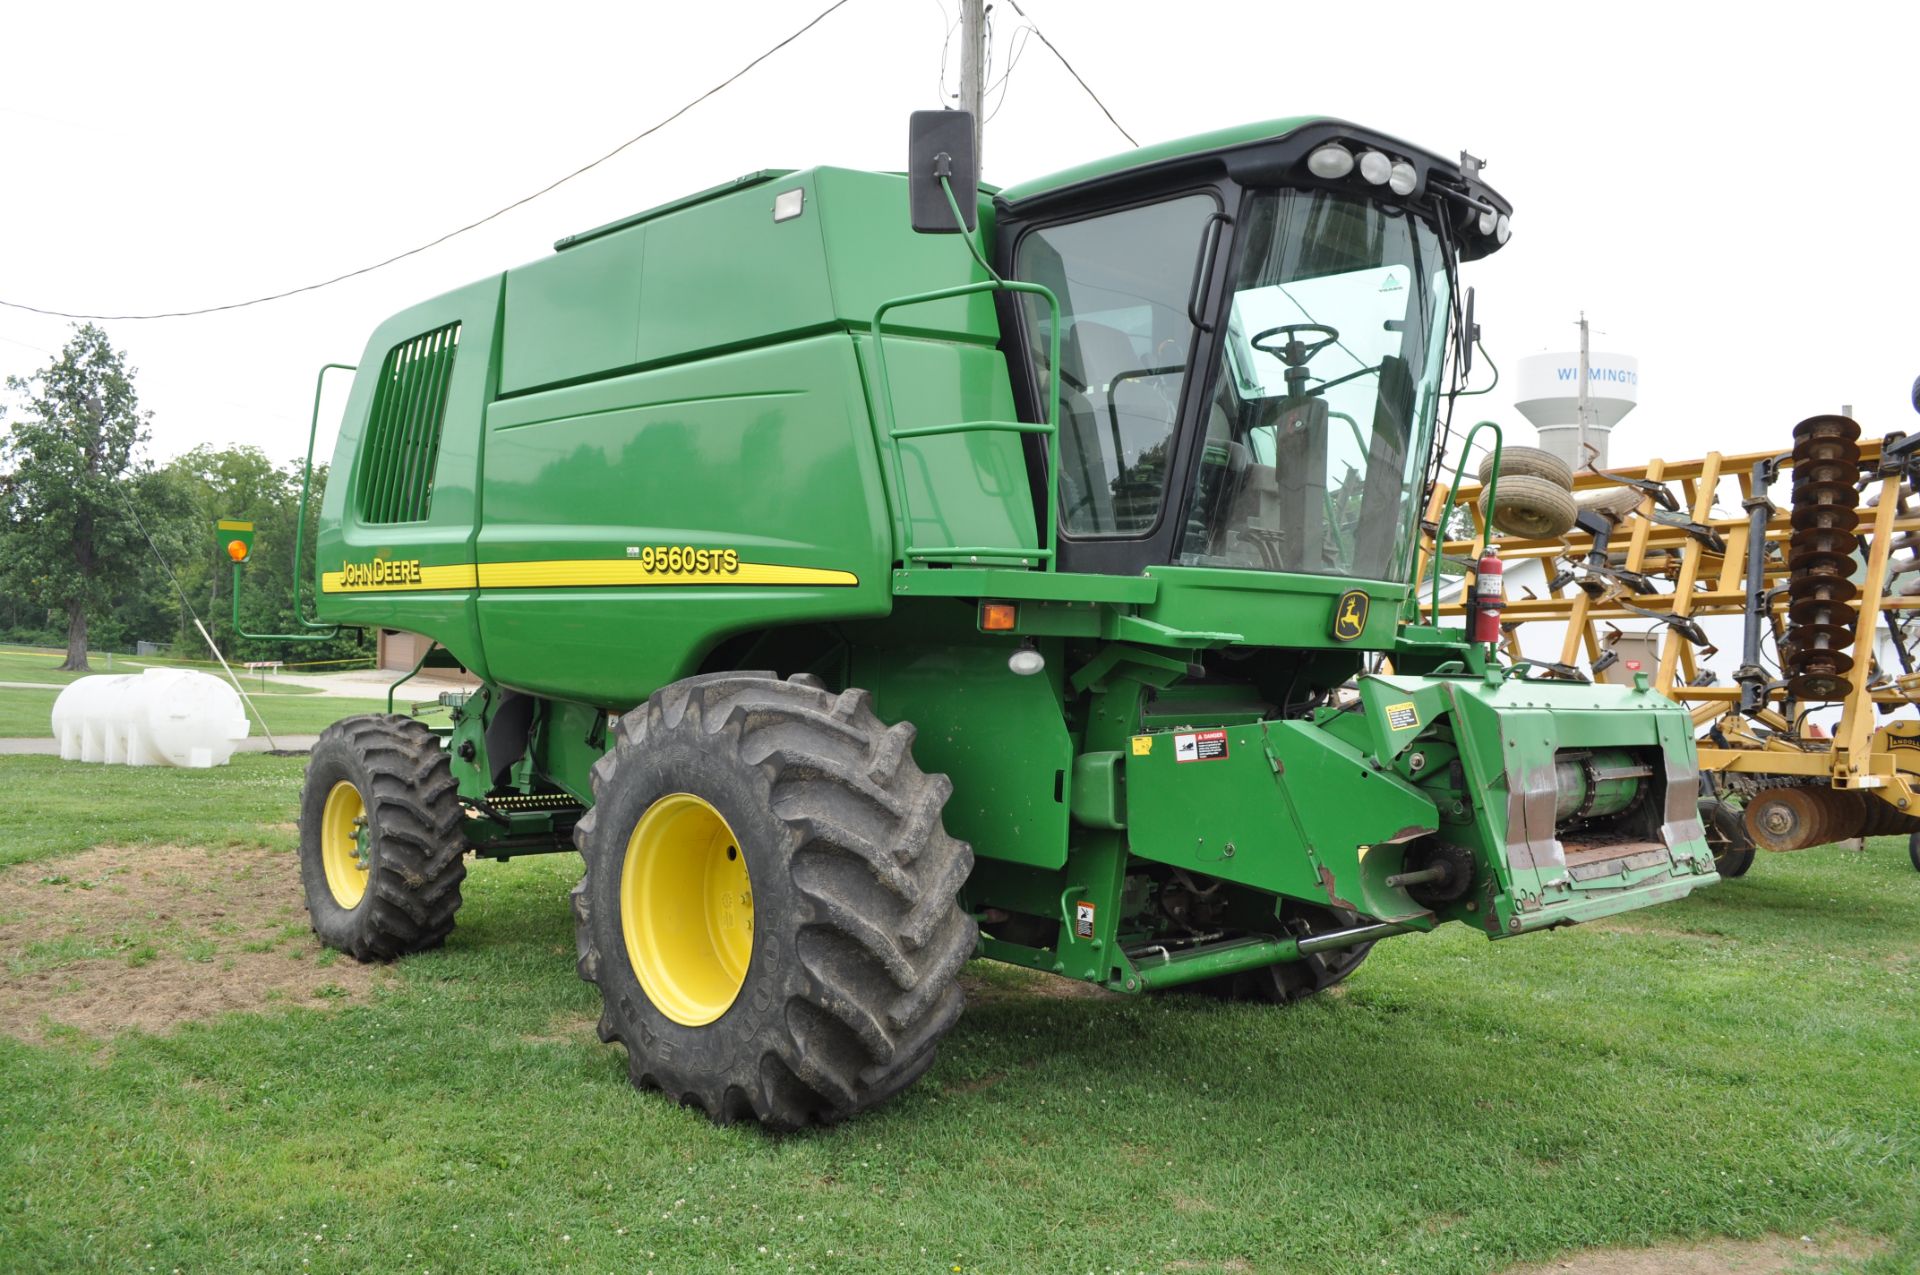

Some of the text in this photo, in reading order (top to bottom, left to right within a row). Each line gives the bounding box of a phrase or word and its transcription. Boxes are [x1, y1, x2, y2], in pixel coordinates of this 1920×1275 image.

[1557, 366, 1638, 385] WIMINGTO
[340, 558, 422, 587] JOHN DEERE
[641, 545, 740, 575] 9560STS
